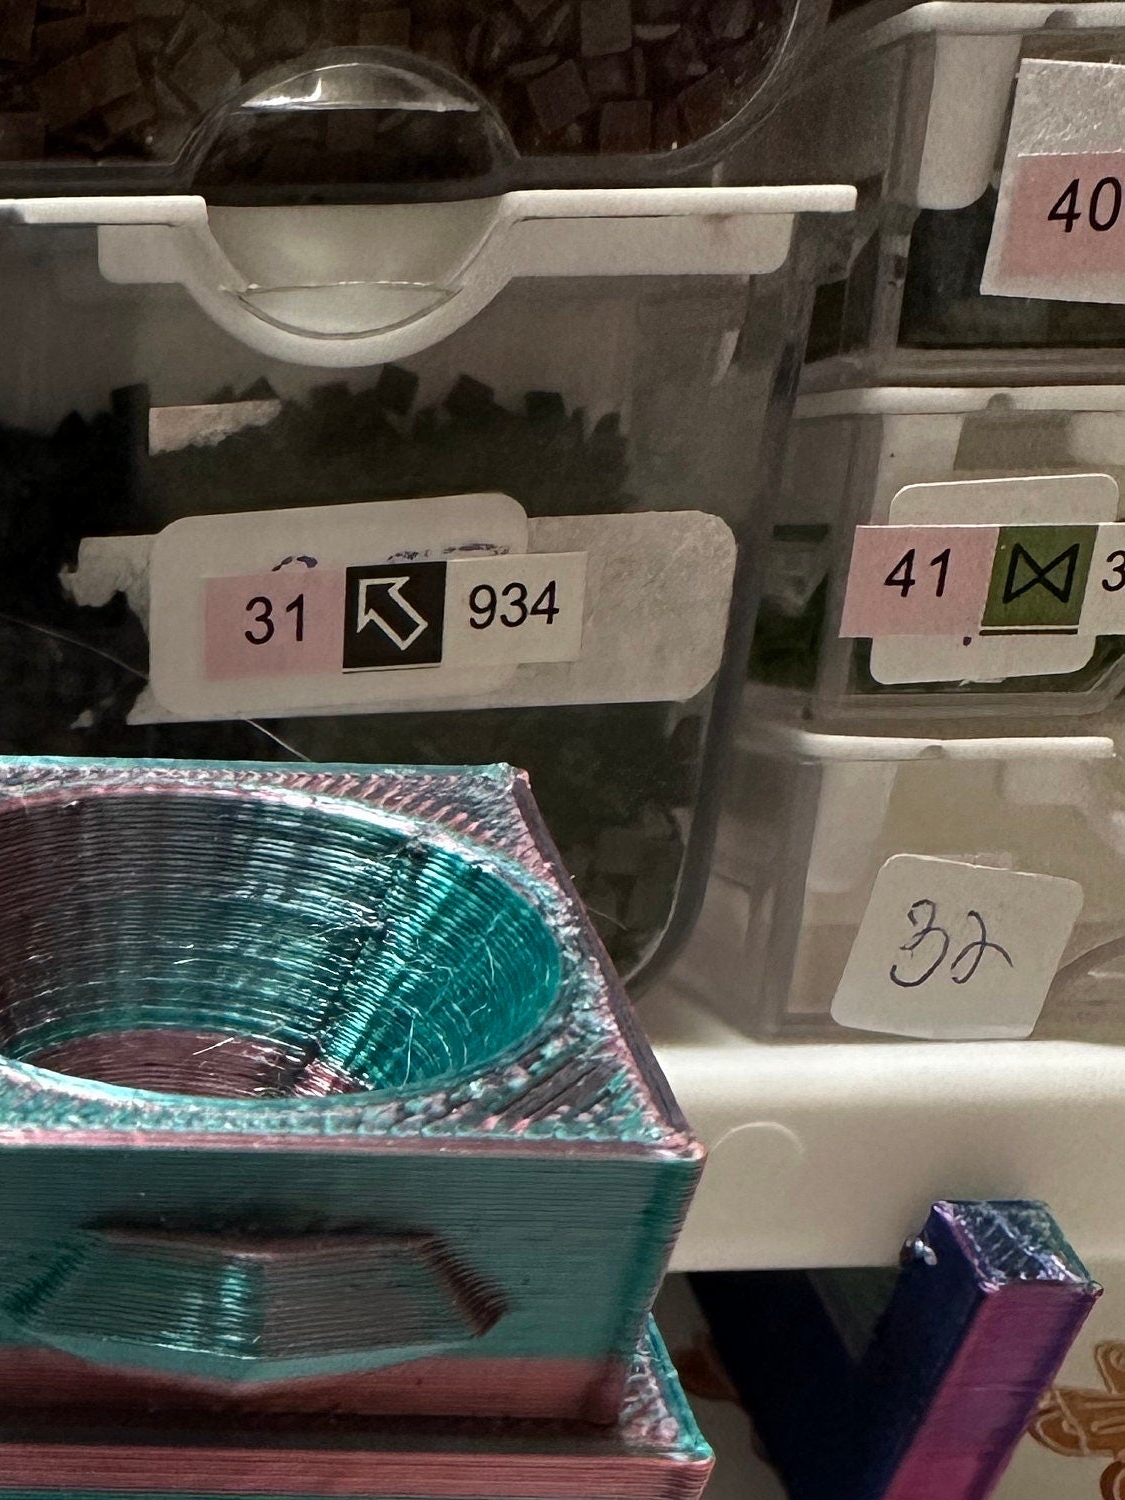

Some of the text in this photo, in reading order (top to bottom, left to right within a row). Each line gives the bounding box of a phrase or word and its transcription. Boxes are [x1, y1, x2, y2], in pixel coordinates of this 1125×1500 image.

[1047, 176, 1123, 233] 40
[883, 548, 953, 598] 41
[244, 580, 560, 646] 31 934
[889, 898, 1014, 988] 32
